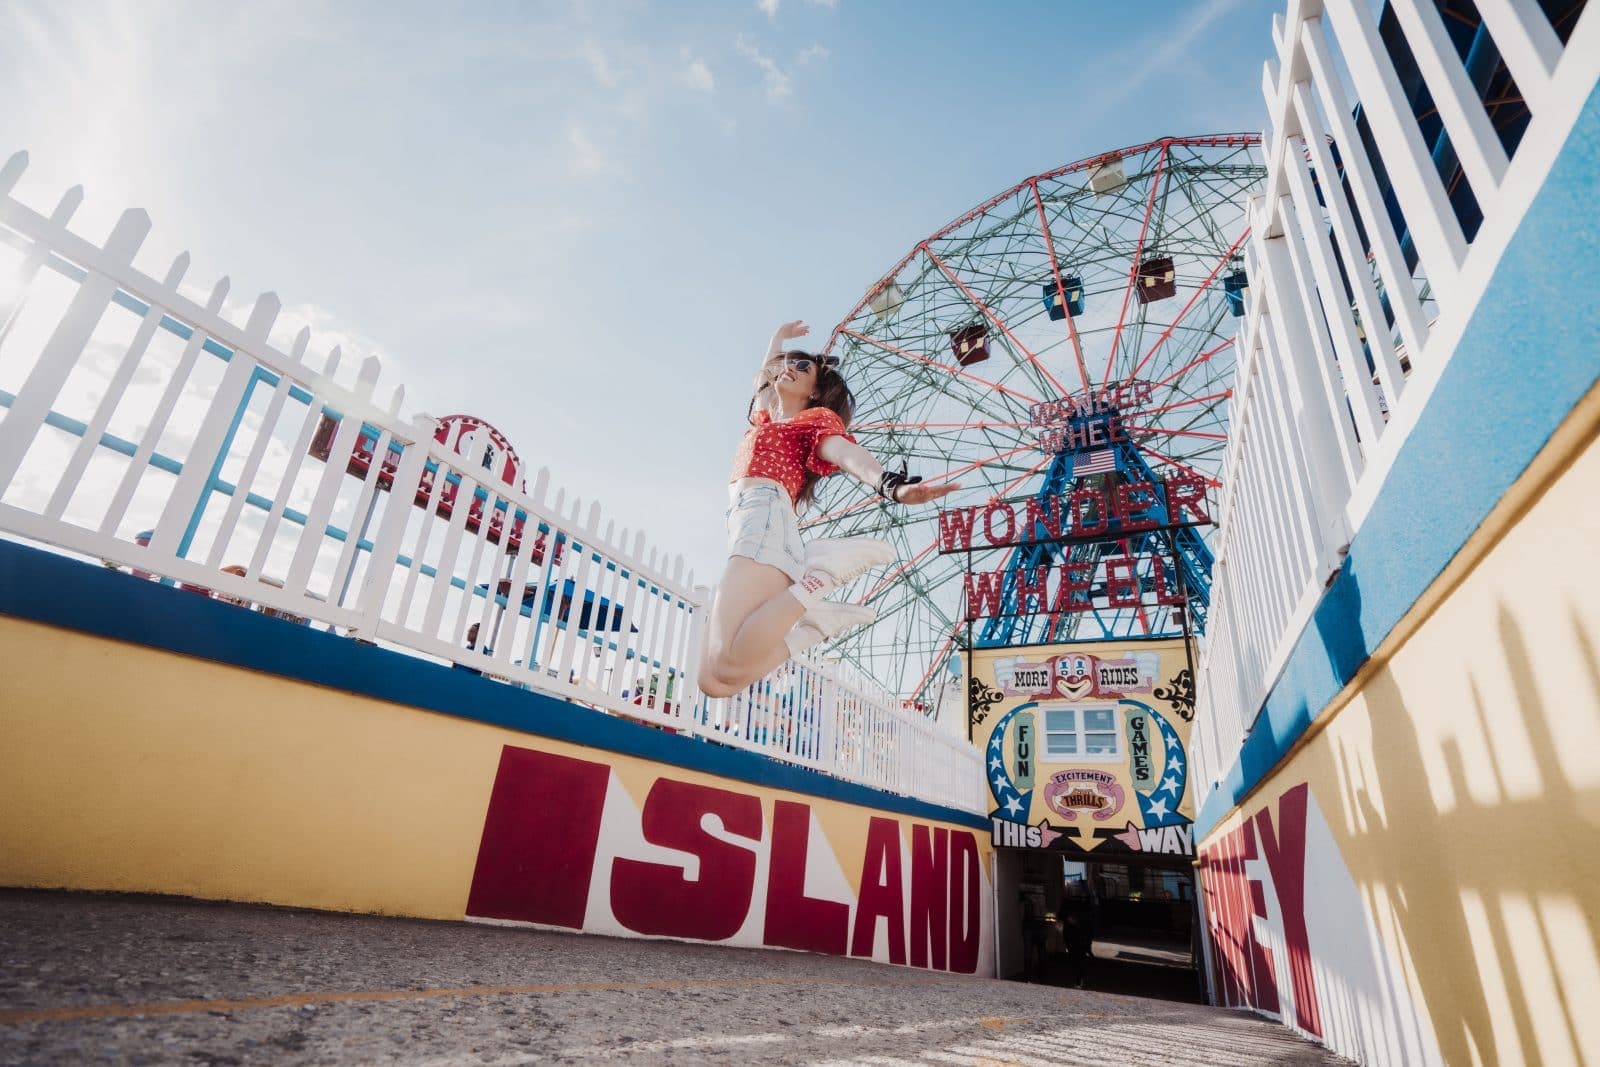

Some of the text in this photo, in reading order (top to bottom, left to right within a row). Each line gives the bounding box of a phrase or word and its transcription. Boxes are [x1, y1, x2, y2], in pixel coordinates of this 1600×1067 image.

[1029, 380, 1154, 428] WONDER
[1039, 413, 1150, 456] WHEEL
[938, 474, 1211, 551] WONDER
[964, 554, 1186, 620] WHEEL
[1014, 667, 1138, 688] MORE RIDES
[1018, 725, 1030, 778] FUN
[1131, 717, 1149, 781] GAMES
[1055, 772, 1112, 784] EXCITEMENT
[1063, 793, 1106, 809] THRILLS
[465, 744, 981, 975] ISLAND
[991, 818, 1195, 856] THIS WAY
